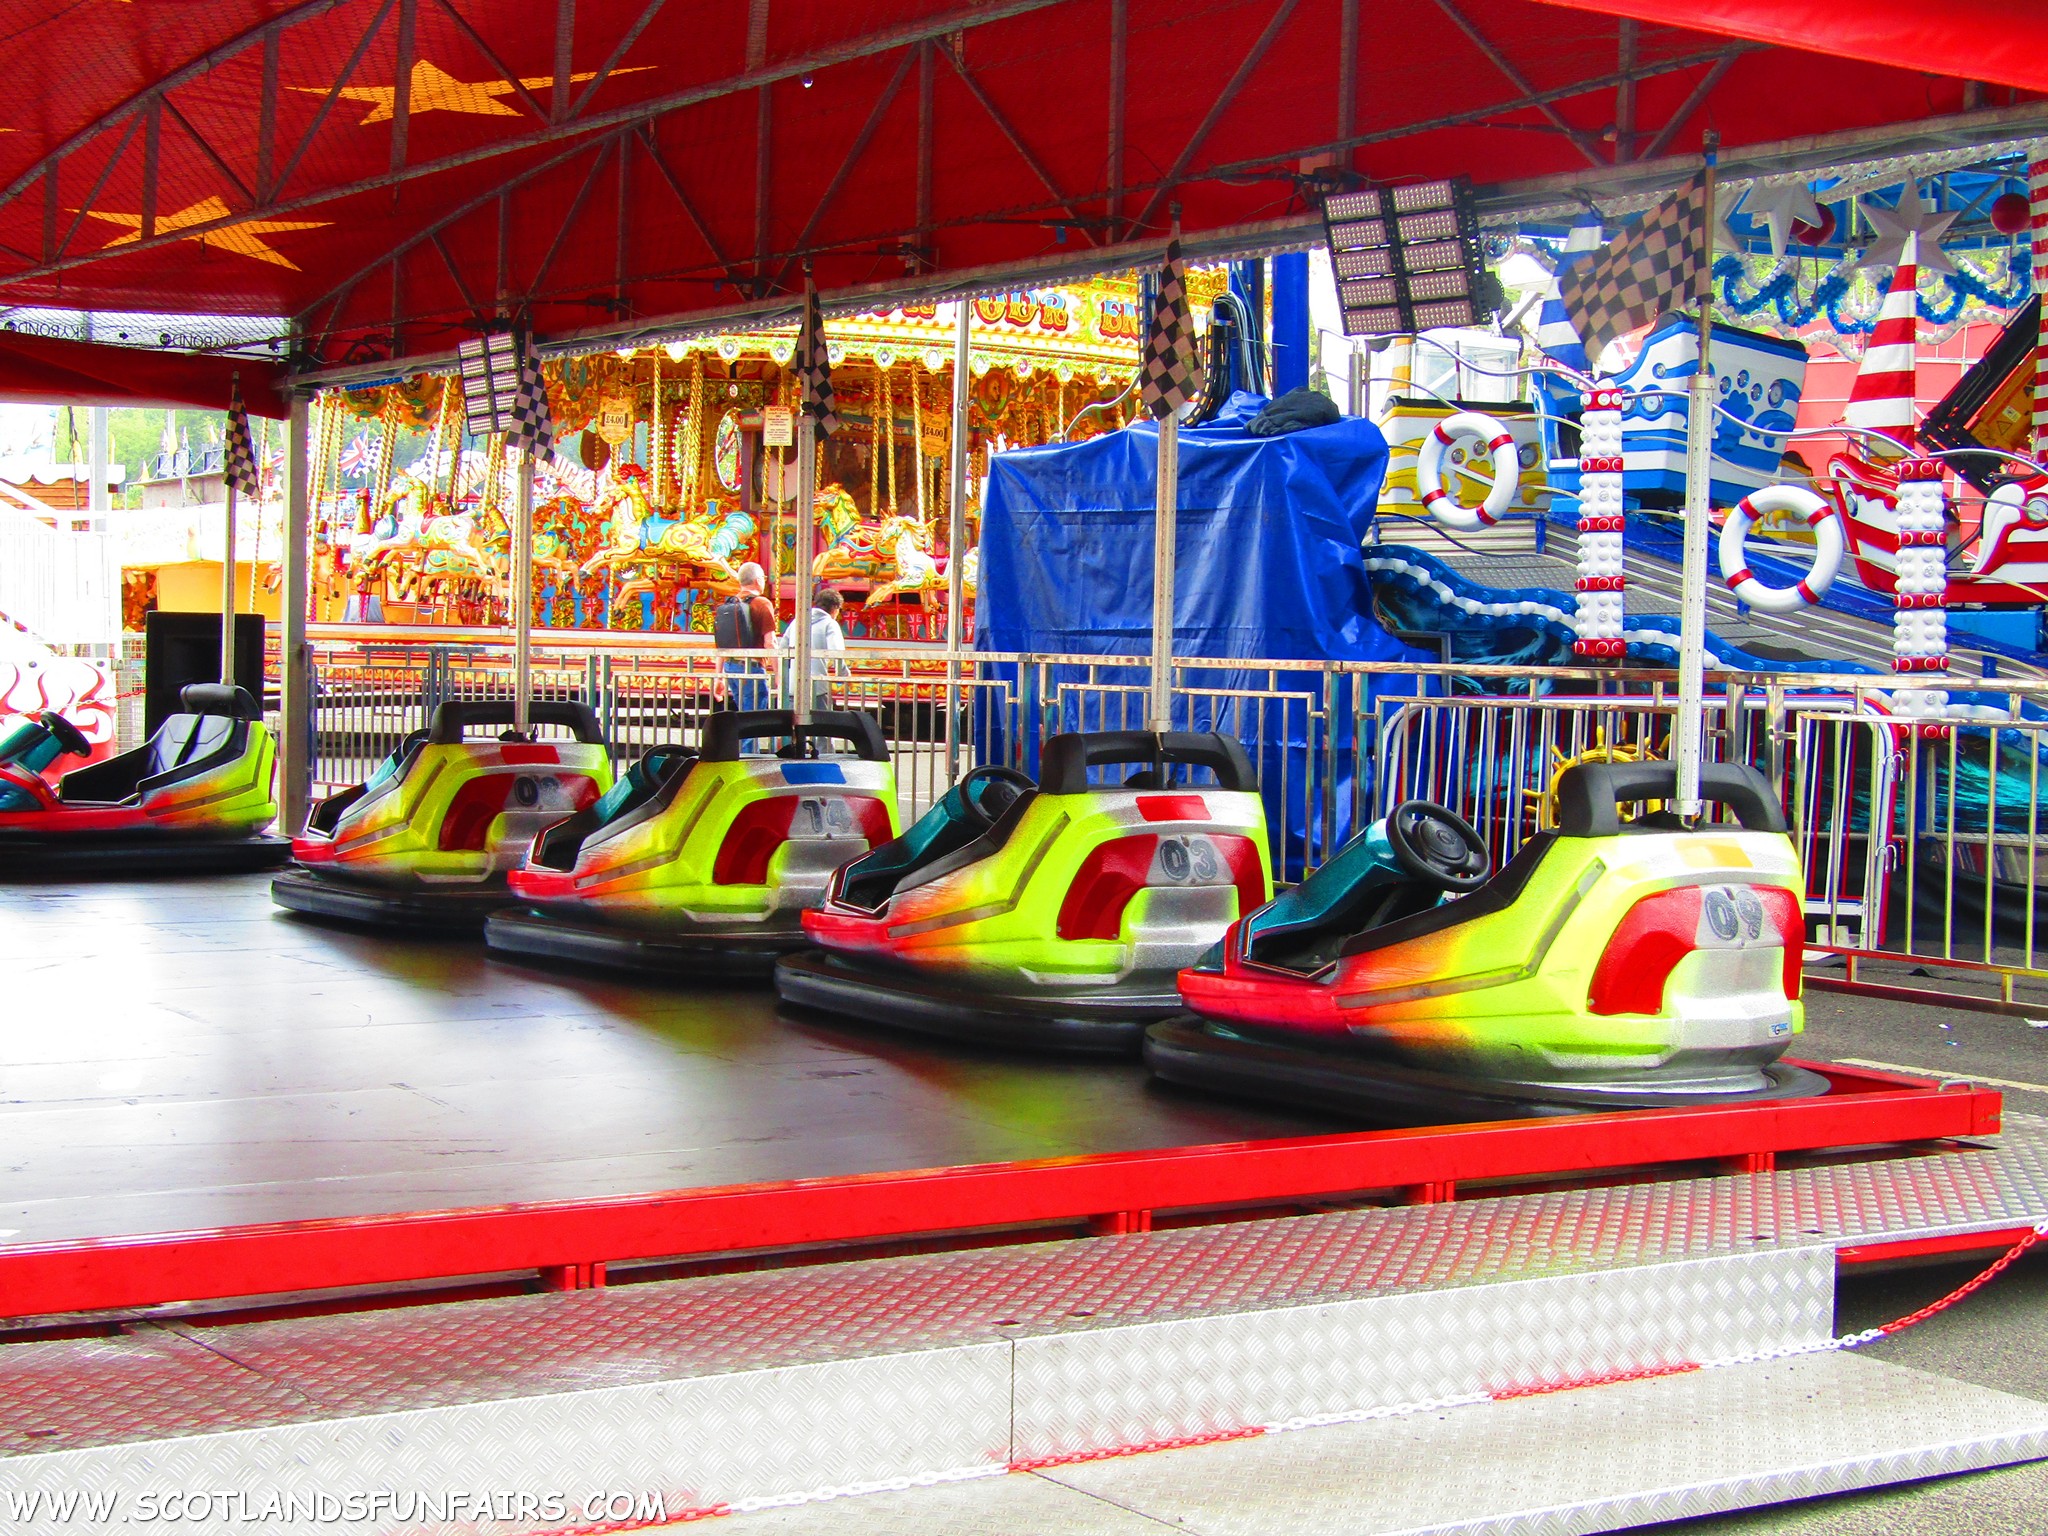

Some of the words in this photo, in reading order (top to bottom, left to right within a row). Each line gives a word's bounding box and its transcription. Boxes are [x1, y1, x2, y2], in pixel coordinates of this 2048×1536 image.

[606, 415, 624, 425] £4.00
[925, 426, 944, 438] £4.00
[1160, 839, 1218, 881] 03
[1704, 889, 1763, 941] 09
